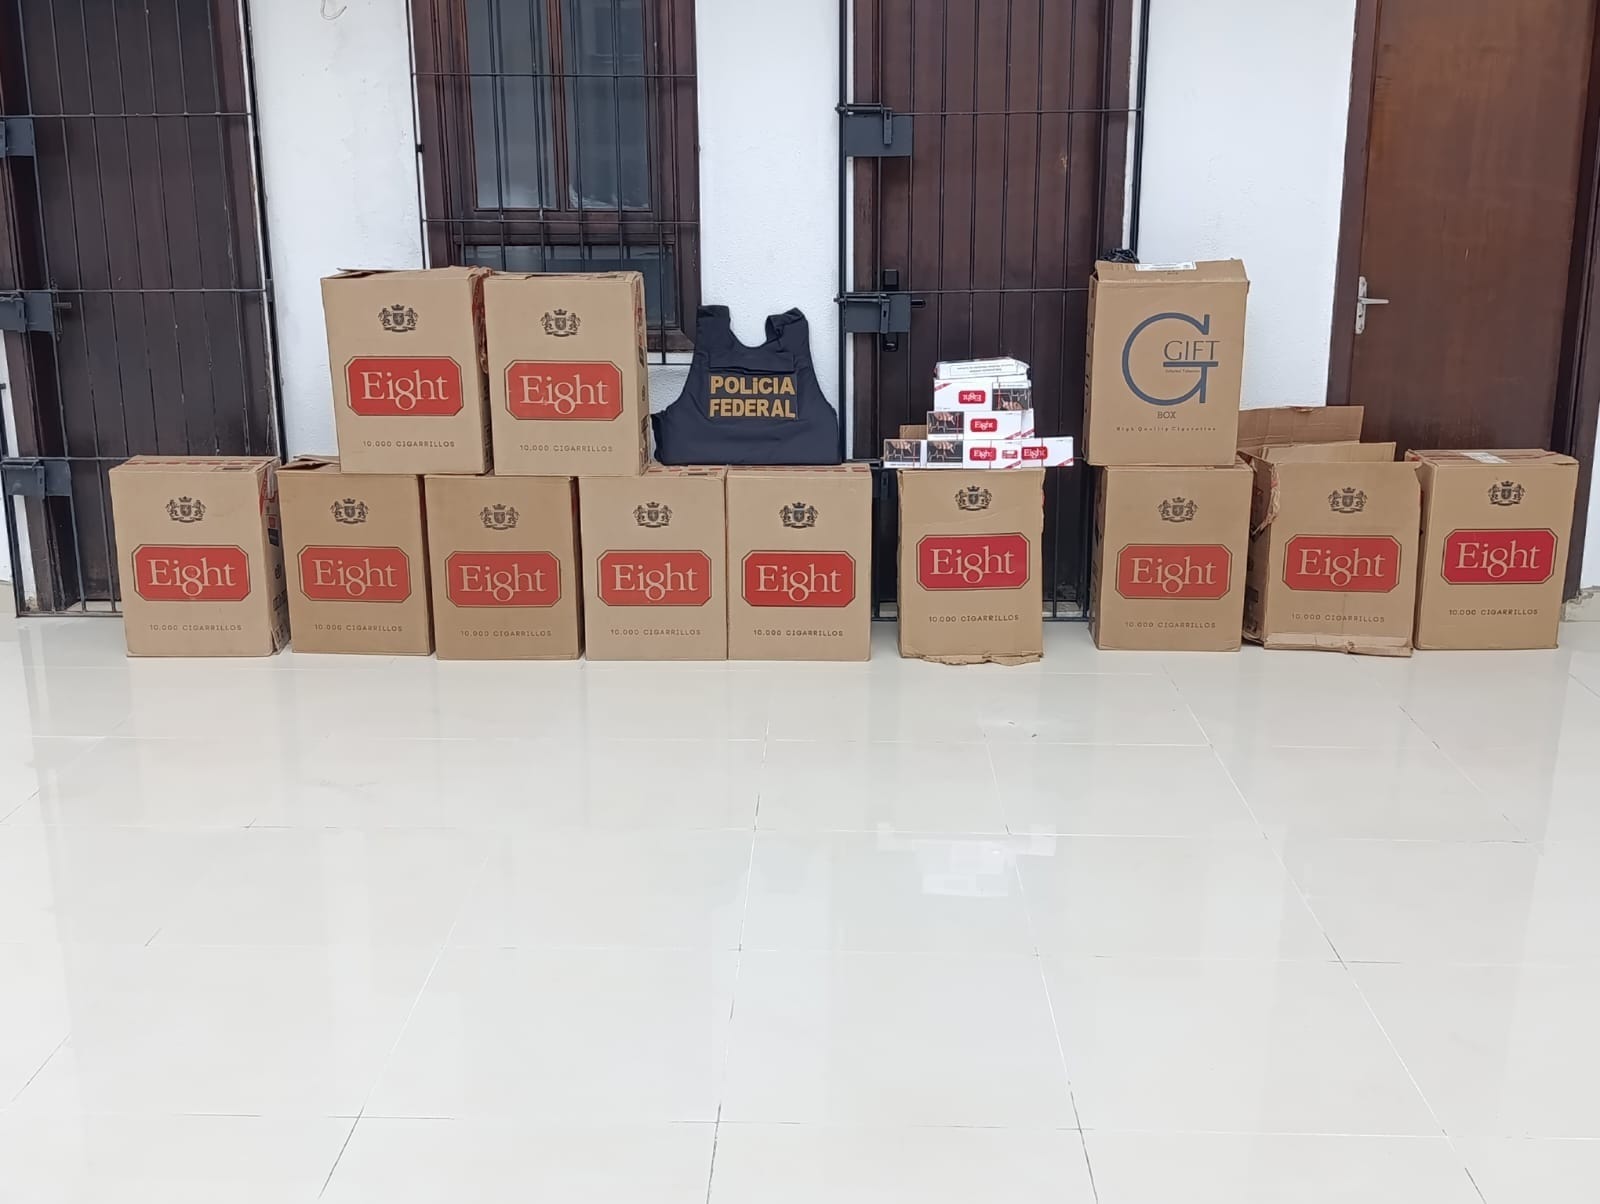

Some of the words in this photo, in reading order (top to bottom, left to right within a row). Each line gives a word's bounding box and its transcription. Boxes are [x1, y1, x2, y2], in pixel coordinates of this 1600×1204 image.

[1163, 340, 1221, 361] GIFT
[360, 366, 448, 411] Eight
[519, 373, 608, 415] Eight
[708, 398, 797, 419] FEDERAL
[1157, 411, 1177, 419] BOX
[974, 420, 994, 431] Eight
[395, 440, 455, 448] CIGARRILLOS
[553, 444, 613, 452] CIGARRILLOS
[930, 545, 1016, 584] Eight
[1296, 546, 1385, 587] Eight
[1455, 539, 1541, 578] Eight
[146, 556, 237, 597] Eight
[312, 557, 397, 597] Eight
[459, 562, 547, 602] Eight
[611, 562, 698, 601] Eight
[755, 563, 841, 602] Eight
[1129, 555, 1217, 594] Eight
[960, 614, 1020, 623] CIGARRILLOS
[1325, 614, 1385, 623] CIGARRILLOS
[1480, 608, 1538, 616] CIGARRILLOS
[346, 624, 403, 632] CIGARRILLOS
[493, 629, 552, 637] CIGARRILLOS
[642, 628, 701, 636] CIGARRILLOS
[785, 629, 844, 637] CIGARRILLOS
[1157, 621, 1216, 629] CIGARRILLOS
